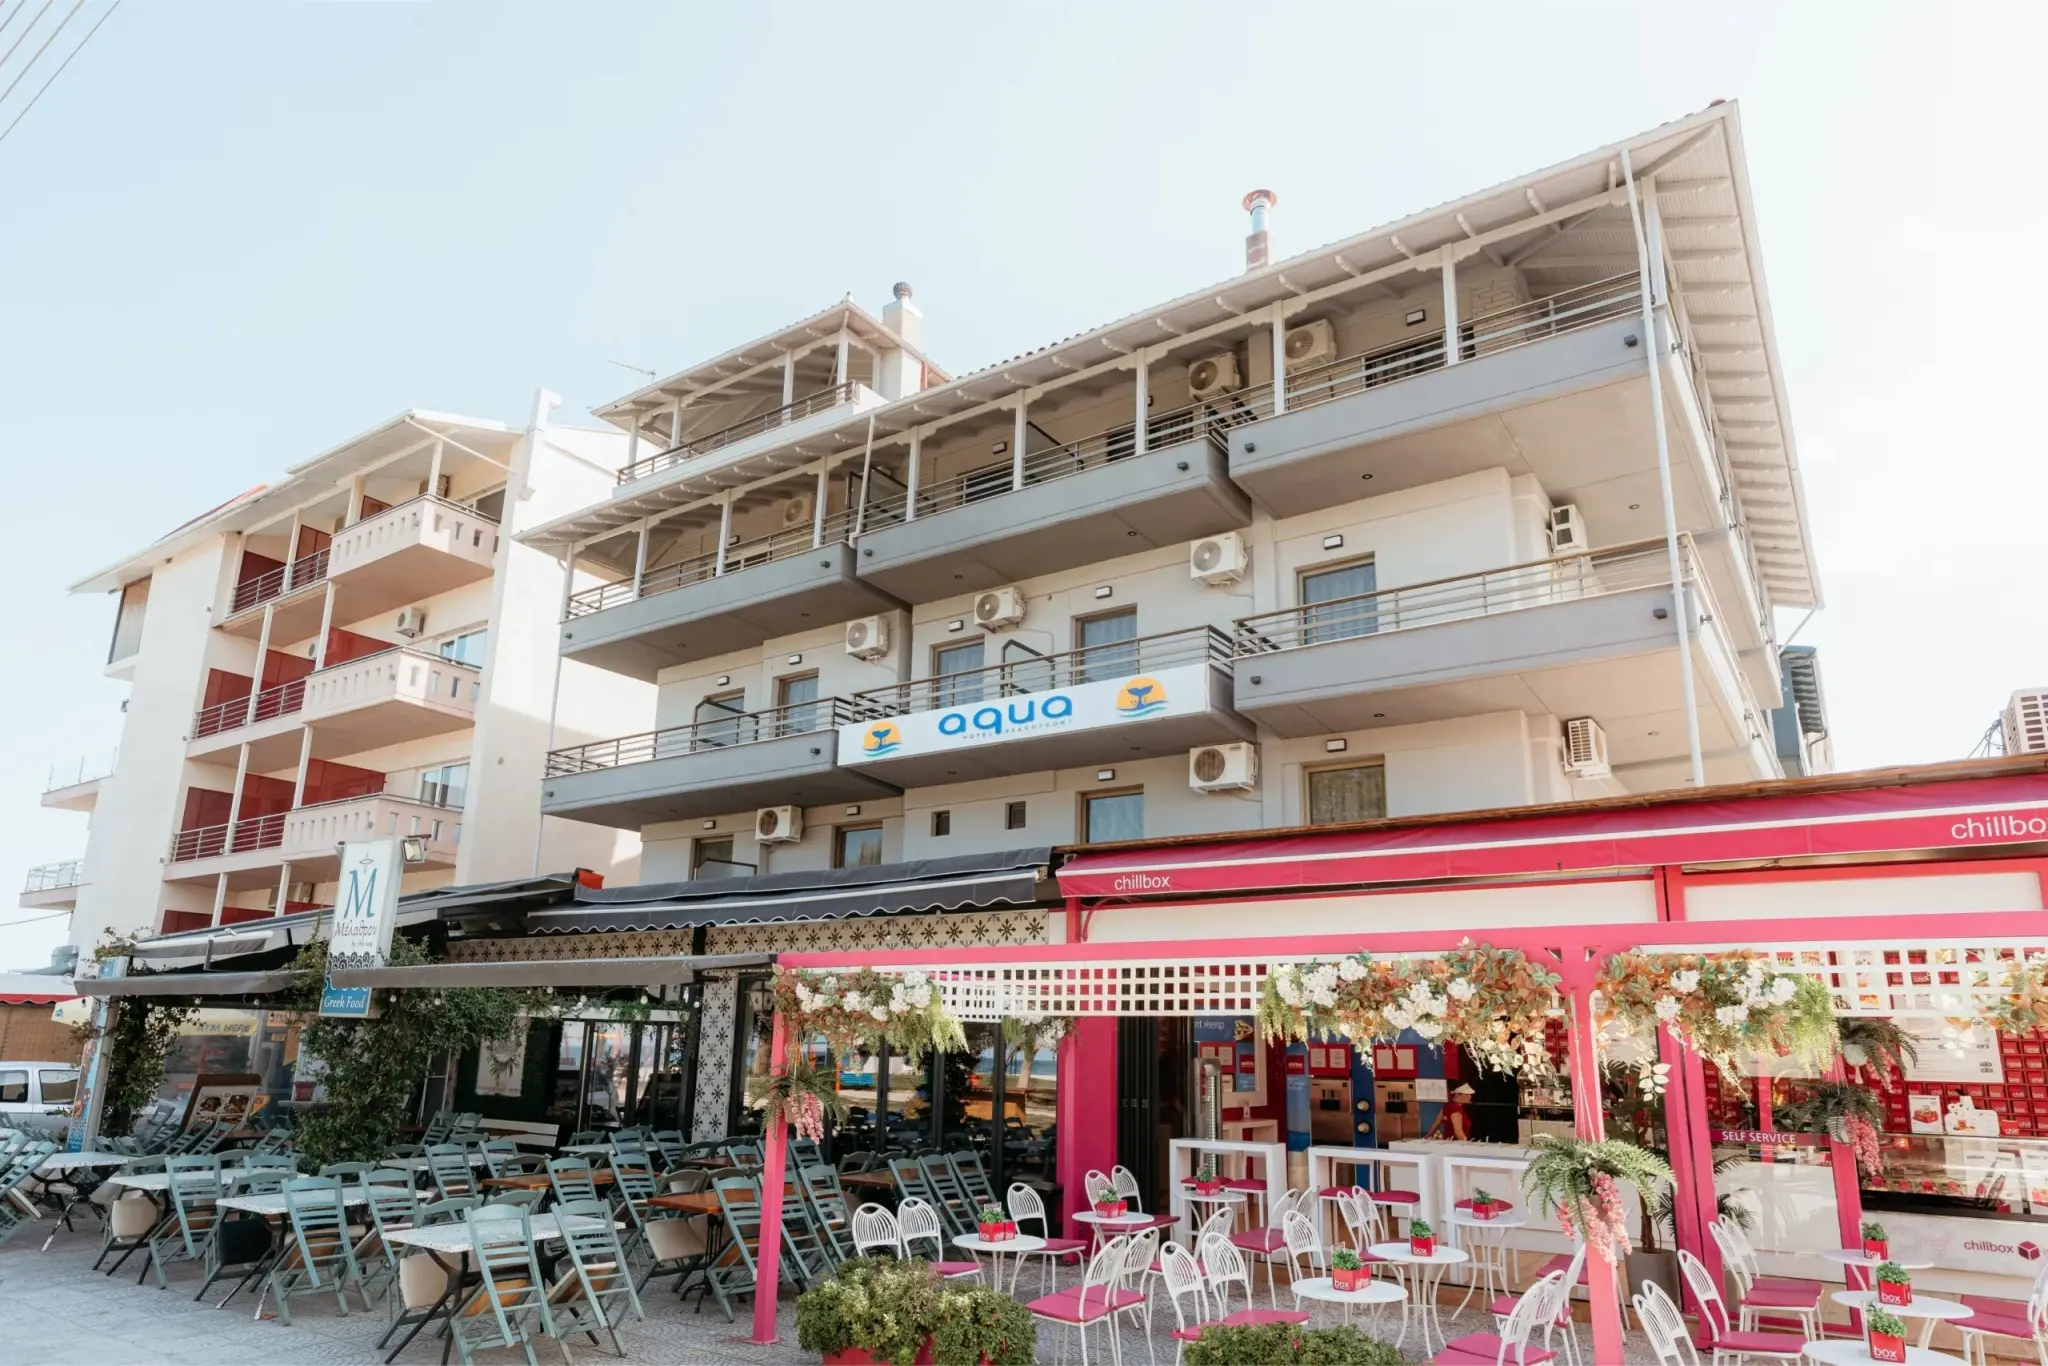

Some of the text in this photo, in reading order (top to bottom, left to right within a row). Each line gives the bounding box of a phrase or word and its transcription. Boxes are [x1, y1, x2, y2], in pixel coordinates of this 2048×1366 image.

[938, 695, 1073, 735] aqua
[962, 719, 1073, 740] HOTEL BEACHFRONT
[1951, 815, 2048, 839] chillbo
[1114, 874, 1170, 890] chillbox
[343, 867, 378, 919] M
[324, 994, 365, 1009] Greek Food
[223, 1023, 252, 1032] HERE
[1722, 1131, 1797, 1144] SELF SERVICE
[1473, 1211, 1485, 1219] box
[1412, 1246, 1427, 1255] box
[1963, 1240, 2015, 1254] chillbox
[1864, 1249, 1882, 1259] box
[1334, 1279, 1349, 1289] box
[1881, 1291, 1901, 1303] box
[1873, 1345, 1898, 1358] box
